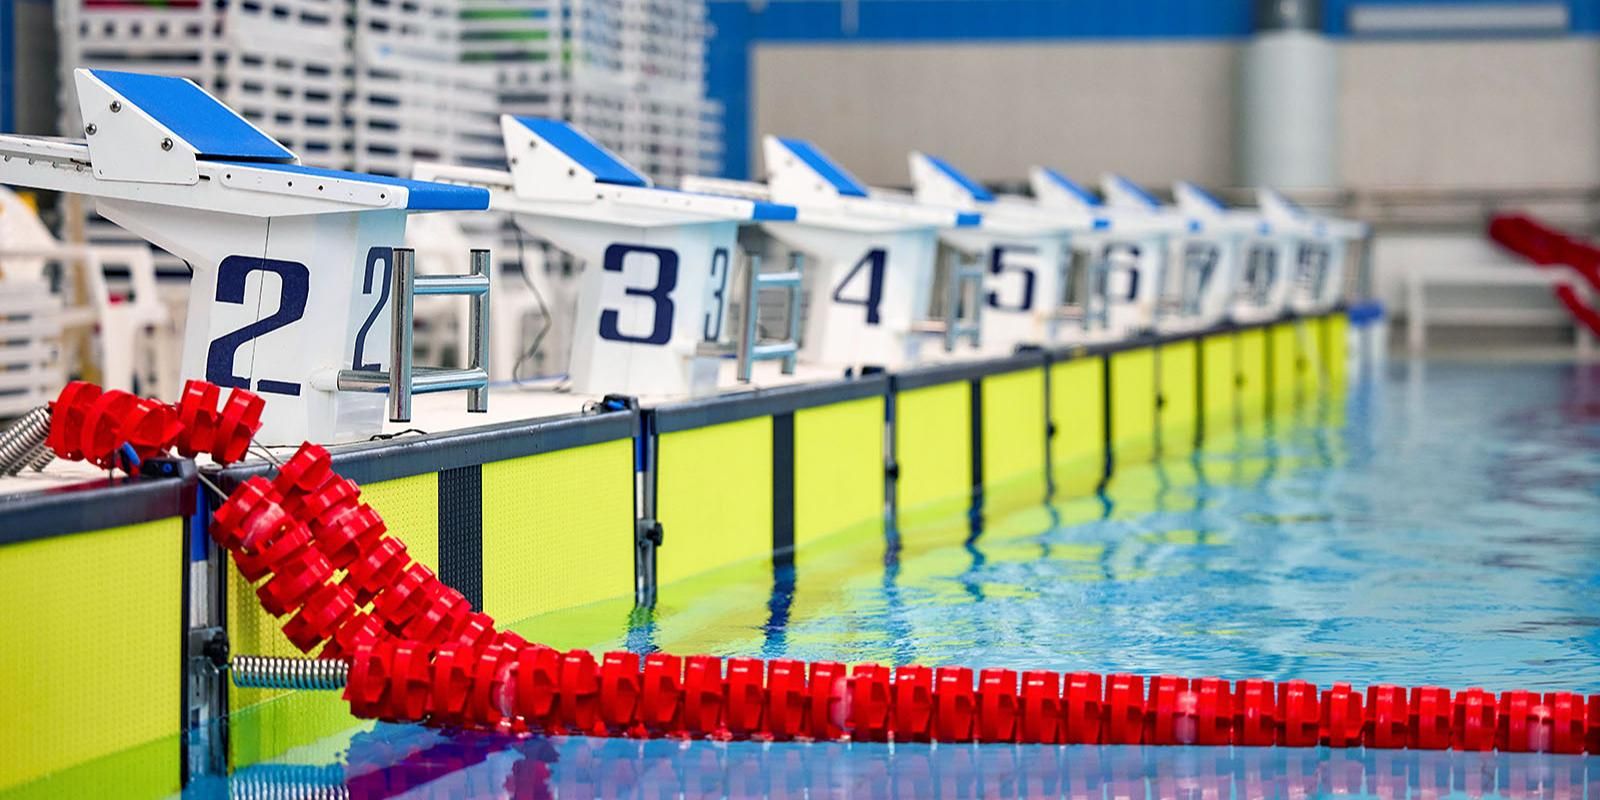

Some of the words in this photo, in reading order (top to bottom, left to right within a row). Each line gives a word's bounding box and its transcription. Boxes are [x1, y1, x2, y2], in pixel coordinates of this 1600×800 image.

[352, 246, 393, 371] 2
[598, 243, 680, 345] 3
[703, 247, 728, 342] 3
[832, 247, 888, 324] 4
[985, 245, 1037, 311] 5
[1101, 243, 1140, 301] 6
[206, 254, 310, 396] 2
